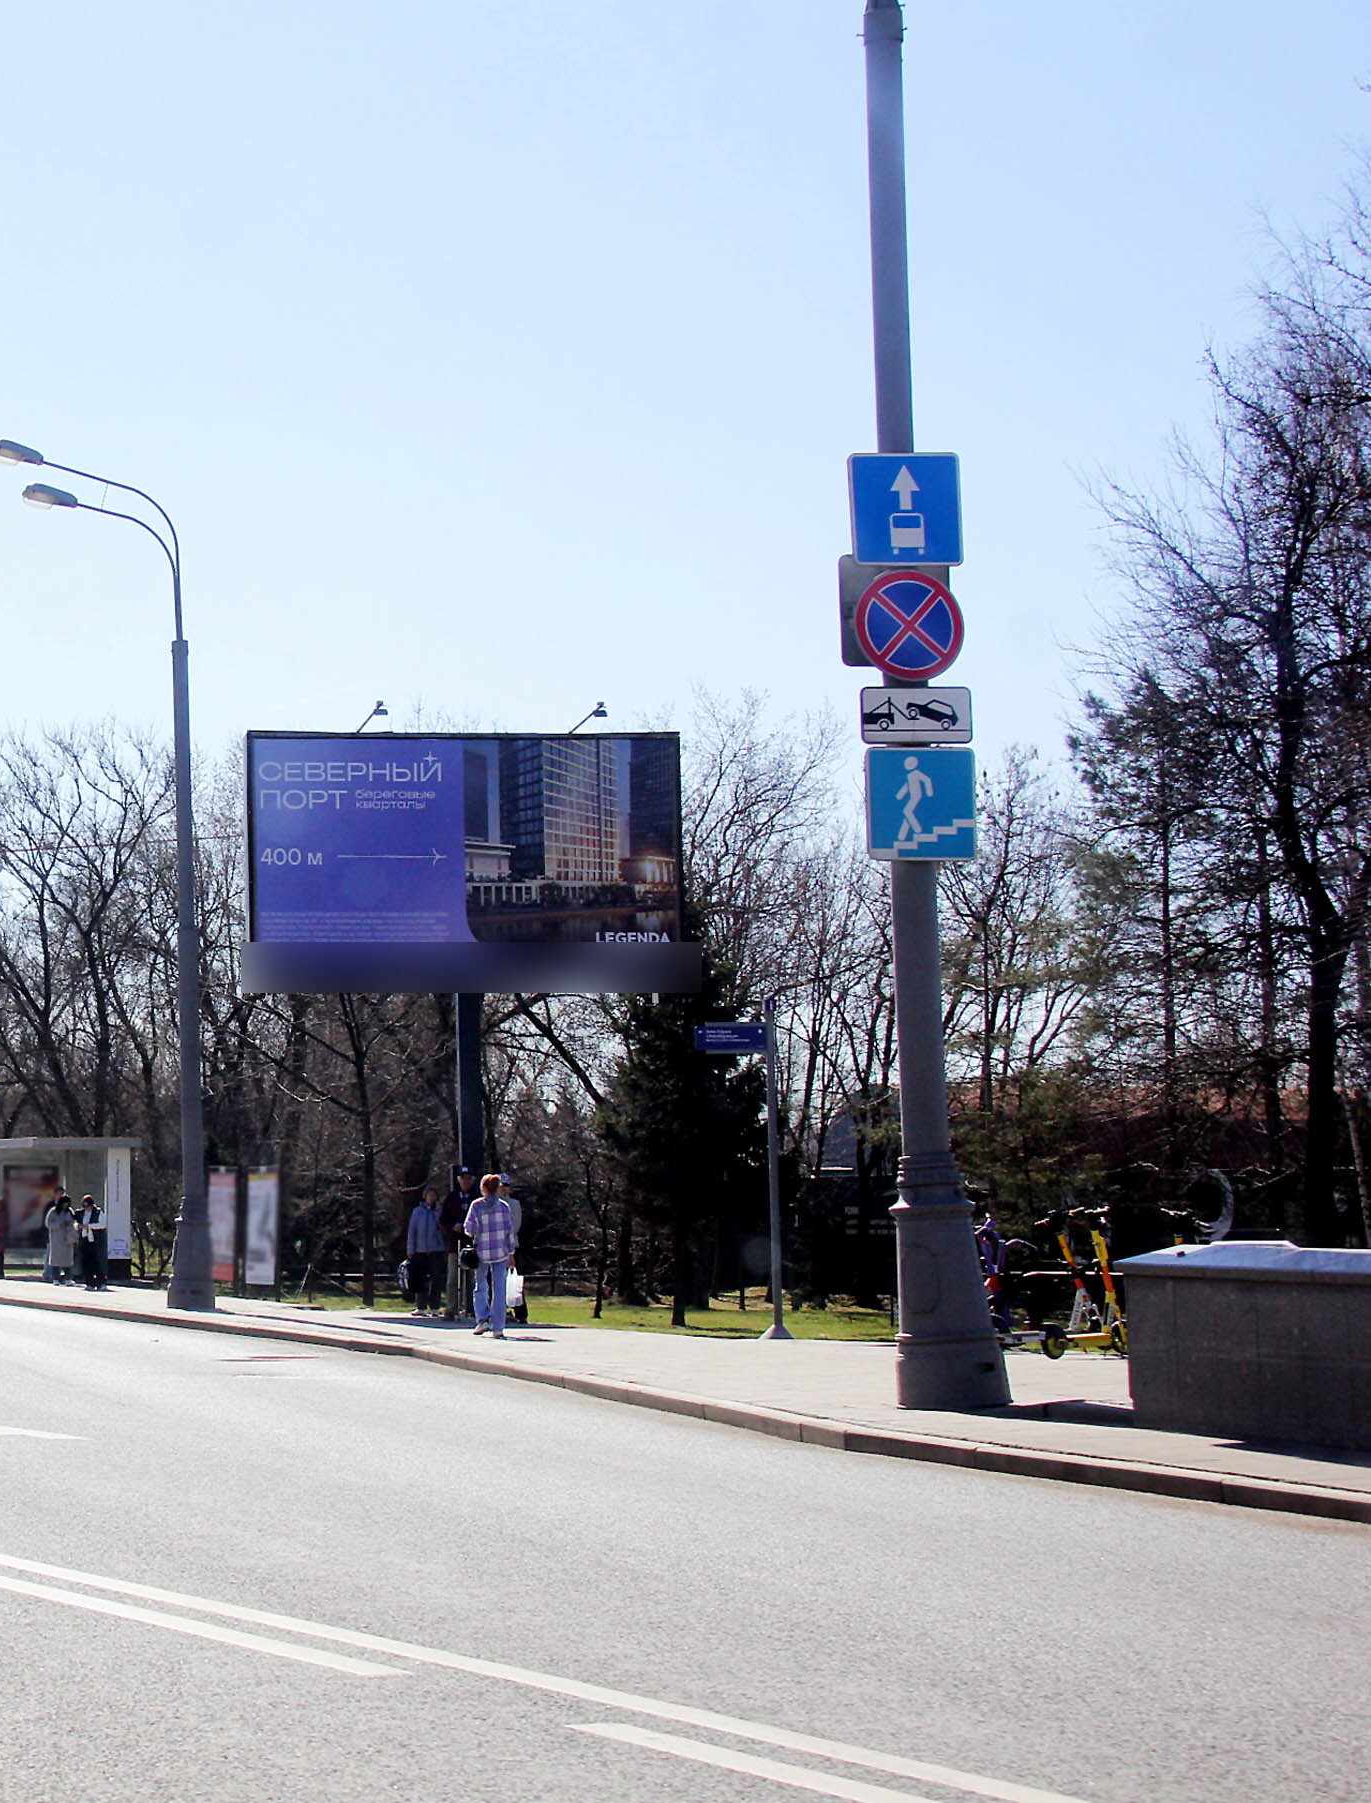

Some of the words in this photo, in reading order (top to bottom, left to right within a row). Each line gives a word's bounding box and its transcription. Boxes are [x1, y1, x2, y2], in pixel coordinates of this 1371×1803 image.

[258, 752, 443, 782] СЕВЕРНЫЙ
[259, 790, 348, 810] ПОРТ
[355, 789, 436, 801] береговые
[355, 800, 426, 811] кварталы
[260, 848, 302, 866] 400
[308, 852, 323, 866] м
[595, 931, 670, 943] LEGENDA
